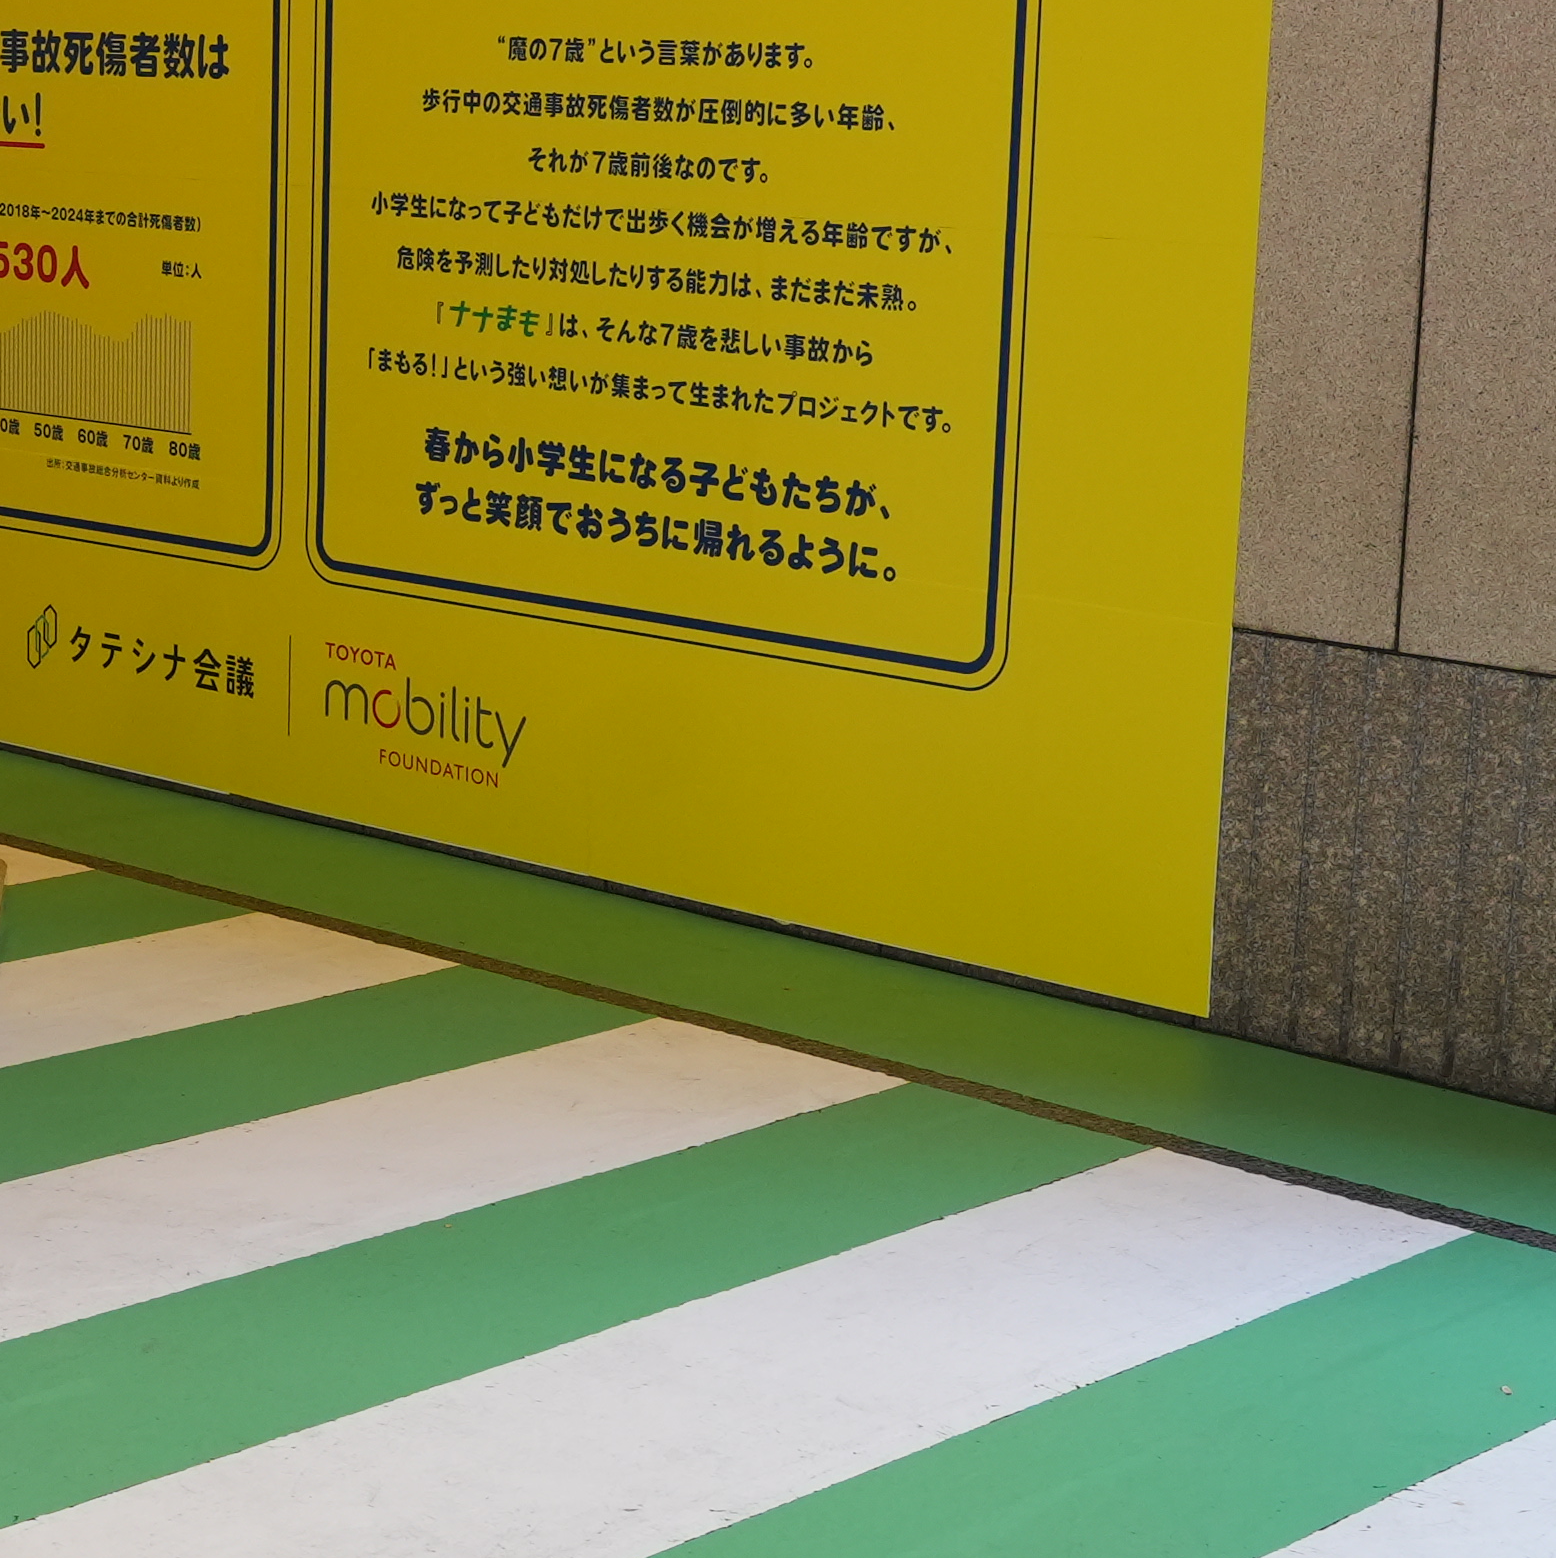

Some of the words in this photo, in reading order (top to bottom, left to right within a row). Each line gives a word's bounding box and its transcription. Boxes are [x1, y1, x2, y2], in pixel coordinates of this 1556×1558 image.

[422, 88, 896, 132] 歩行中の交通事故死傷者数が圧倒的に多い年齢、
[528, 147, 769, 185] それが7歳前後なのです。
[371, 191, 953, 255] 小学生になって子どもだけで出歩く機会が増える年齢ですが、
[396, 245, 918, 312] 危険を予測したり対処したりする能力は、まだまだ未熟。
[436, 300, 874, 367] 『ナナまも』は、そんな7歳を悲しい事故から
[34, 422, 64, 442] 50歳
[77, 428, 108, 448] 60歳
[123, 434, 154, 455] 70歳
[169, 441, 201, 461] 80歳
[424, 426, 891, 520] 春から小学生になる子どもたちが、
[415, 481, 897, 582] ずっと笑顔でおうちに帰れるように。
[69, 626, 255, 699] タテシナ会議
[325, 642, 397, 671] TOYOTA
[324, 676, 527, 768] mobility
[379, 749, 500, 788] FOUNDATION
